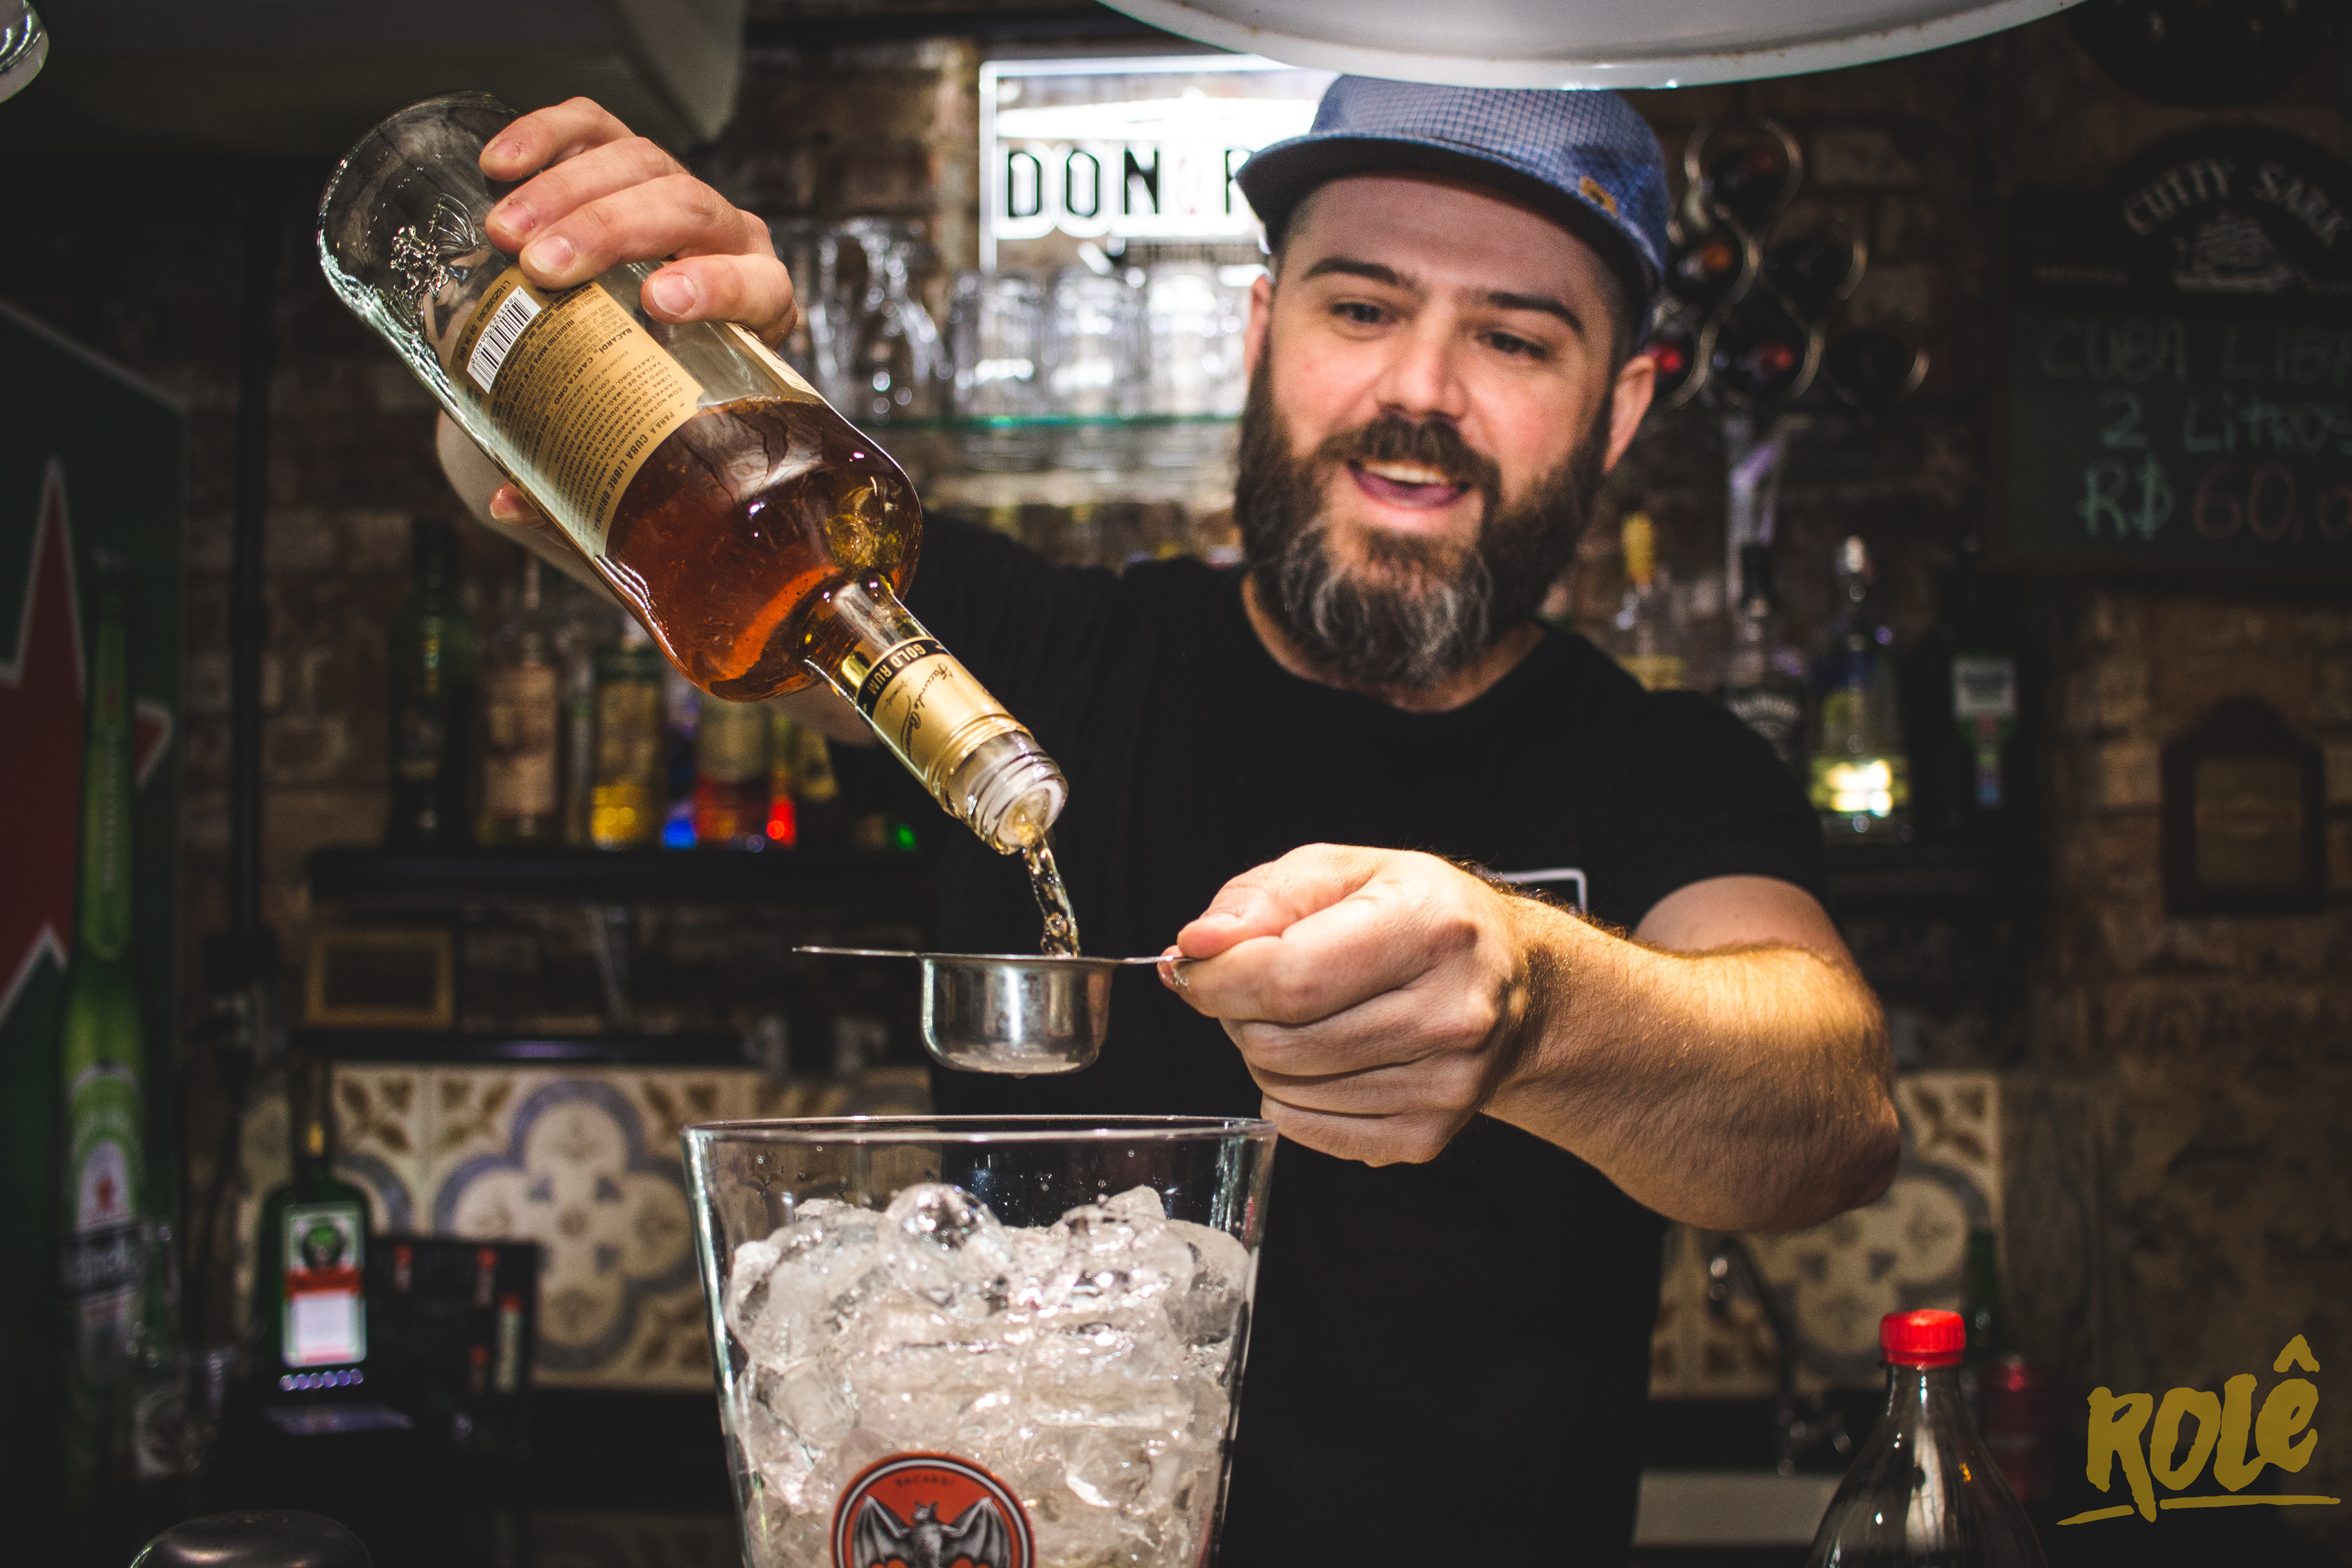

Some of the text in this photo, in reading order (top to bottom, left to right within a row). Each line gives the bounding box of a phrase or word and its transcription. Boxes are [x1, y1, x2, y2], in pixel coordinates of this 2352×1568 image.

[2123, 157, 2236, 236] CUTTY
[475, 279, 511, 323] L18253SE300
[541, 303, 554, 315] EVITE
[488, 297, 514, 330] 891125
[535, 311, 554, 331] SEMPRE
[519, 317, 540, 341] CONSUMO
[527, 330, 537, 341] QUE
[546, 318, 575, 347] REGISTRO
[470, 330, 489, 366] 064076
[507, 340, 529, 372] CONSERVADO
[533, 345, 549, 364] MAPA
[2038, 320, 2188, 385] CUBA
[527, 363, 535, 374] SP
[567, 356, 594, 385] CARTA
[600, 350, 629, 375] ENCONTRE
[631, 354, 655, 372] CARTA
[636, 361, 661, 379] FATIAS
[587, 374, 601, 388] ESSA
[627, 378, 636, 387] DE
[649, 366, 668, 380] COPO
[652, 374, 671, 389] LIBRE
[553, 385, 568, 405] ORO
[593, 379, 610, 396] COLA
[598, 385, 616, 403] DUAS
[667, 386, 683, 399] COM
[570, 396, 594, 429] FAVORITO
[580, 402, 600, 429] PARTES
[603, 394, 631, 424] COLOQUE
[622, 396, 642, 415] DRINK
[644, 398, 667, 418] NOTAS
[583, 407, 607, 440] ADICIONE
[636, 417, 645, 426] DE
[655, 411, 675, 429] PARA
[2096, 387, 2149, 450] 2
[573, 428, 581, 440] DO
[591, 423, 605, 442] GELO
[598, 414, 624, 447] ORIGINAL
[575, 440, 584, 456] UMA
[586, 441, 593, 452] EM
[592, 446, 600, 458] DA
[599, 437, 616, 461] CARTA
[625, 433, 649, 461] CUBA
[590, 460, 601, 477] ORO
[606, 459, 628, 492] LIBRE
[592, 489, 611, 537] ORIGINAL
[867, 643, 927, 696] GOLD RUM
